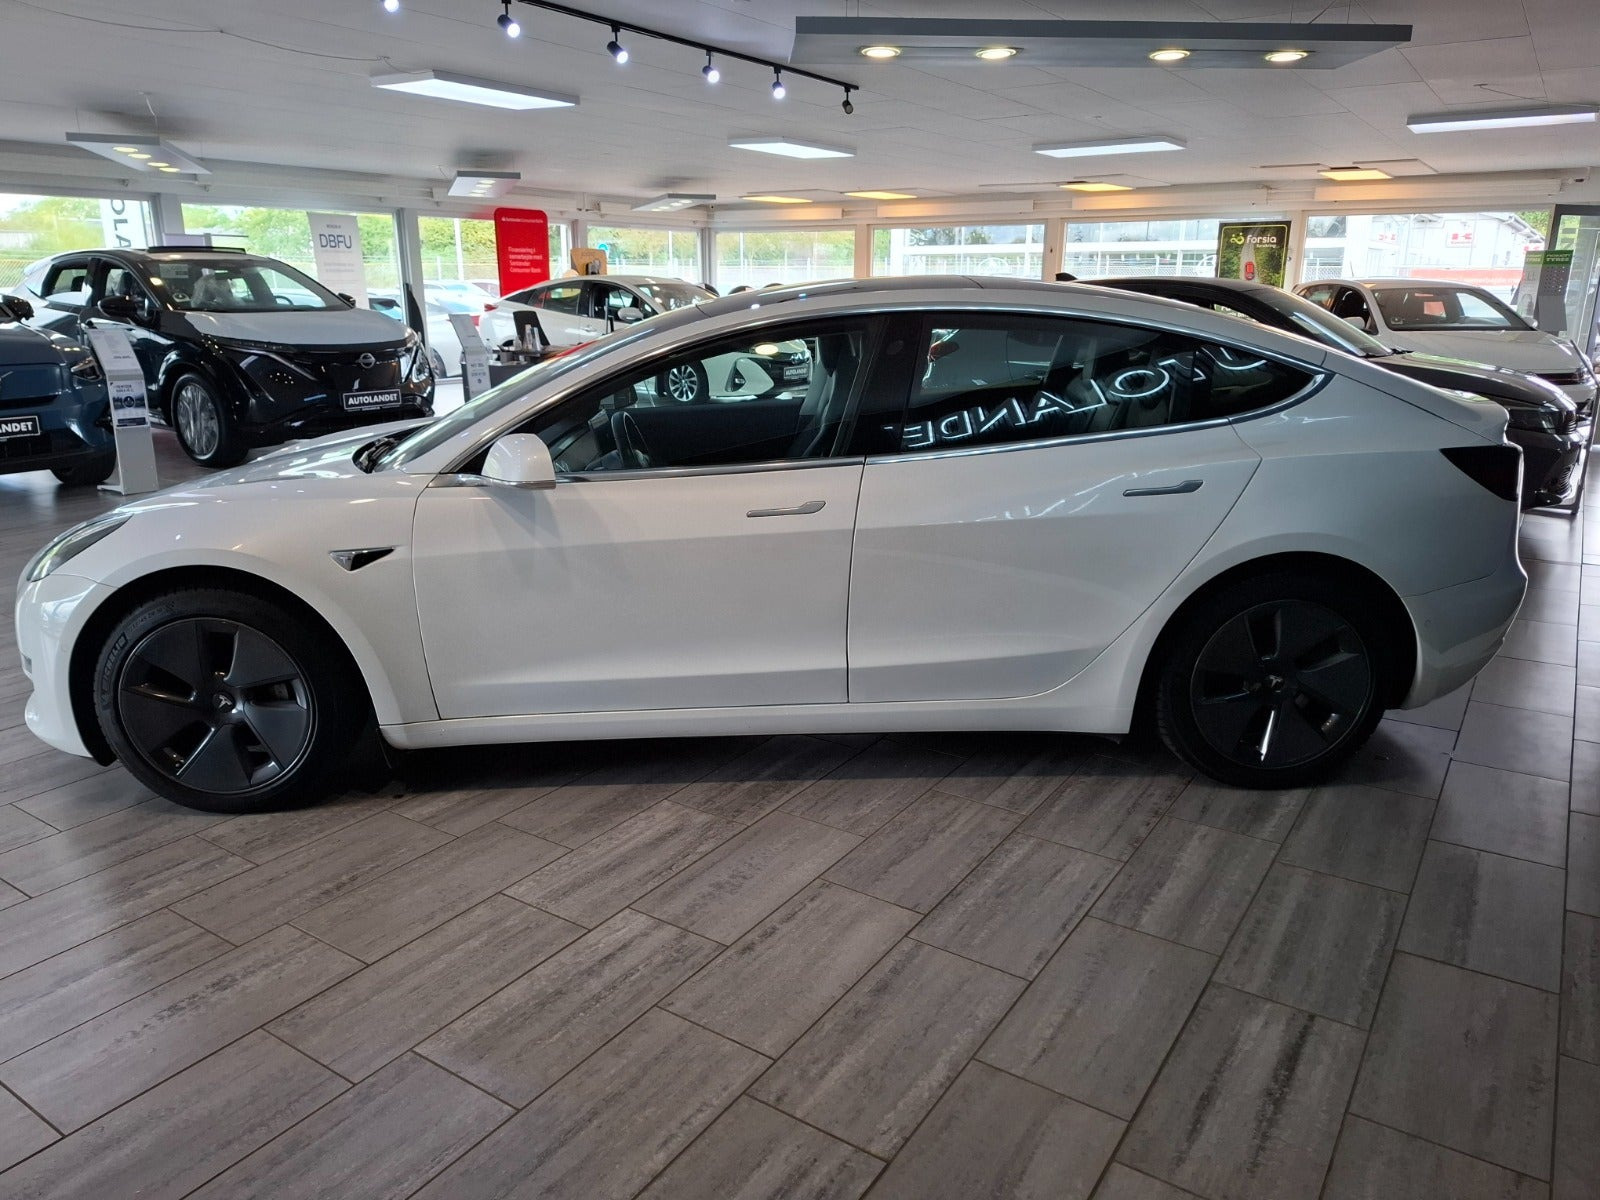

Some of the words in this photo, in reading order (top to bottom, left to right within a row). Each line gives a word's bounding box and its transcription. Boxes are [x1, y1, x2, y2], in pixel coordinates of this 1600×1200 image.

[319, 234, 352, 249] DBFU
[1246, 234, 1277, 244] forsia
[348, 393, 398, 405] AUTOLANDET
